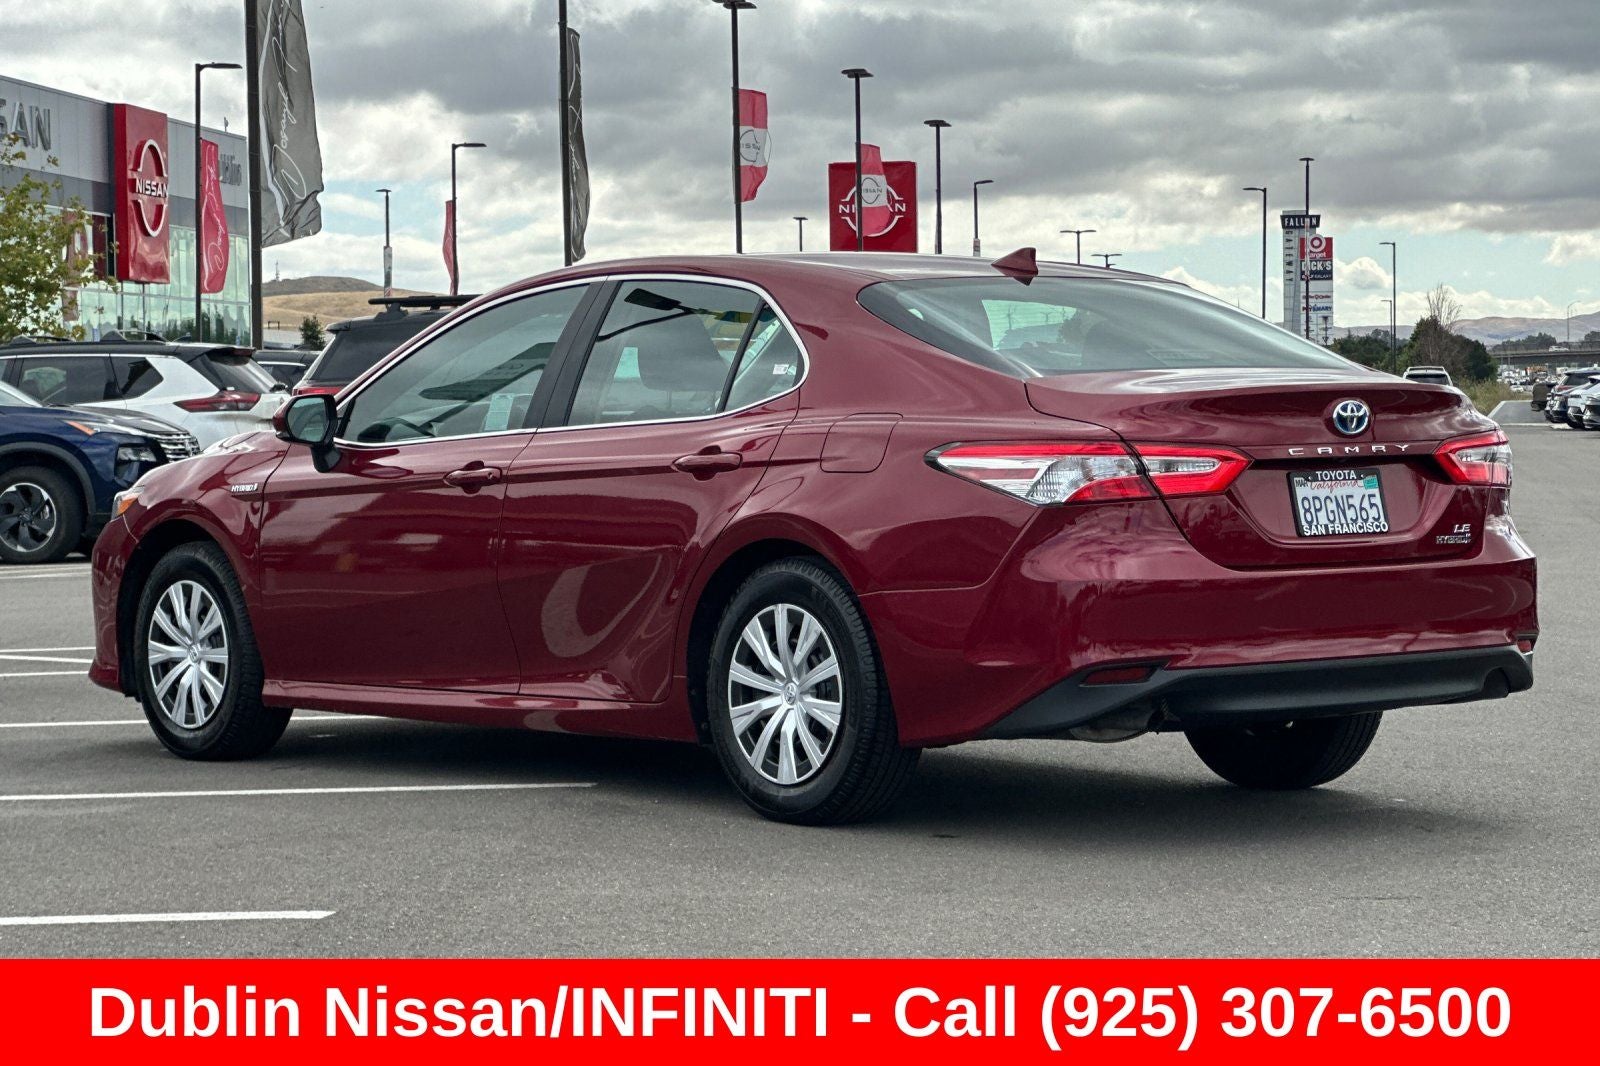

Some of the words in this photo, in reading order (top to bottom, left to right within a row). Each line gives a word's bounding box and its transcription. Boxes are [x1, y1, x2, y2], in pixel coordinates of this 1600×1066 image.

[135, 177, 169, 198] NISSAN
[1288, 444, 1409, 456] CAMRY
[1316, 470, 1357, 481] TOYOTA
[1301, 493, 1382, 526] 8PGN565
[1303, 525, 1326, 536] SAN
[1328, 521, 1388, 535] FRANCISCO
[1453, 523, 1471, 533] LE
